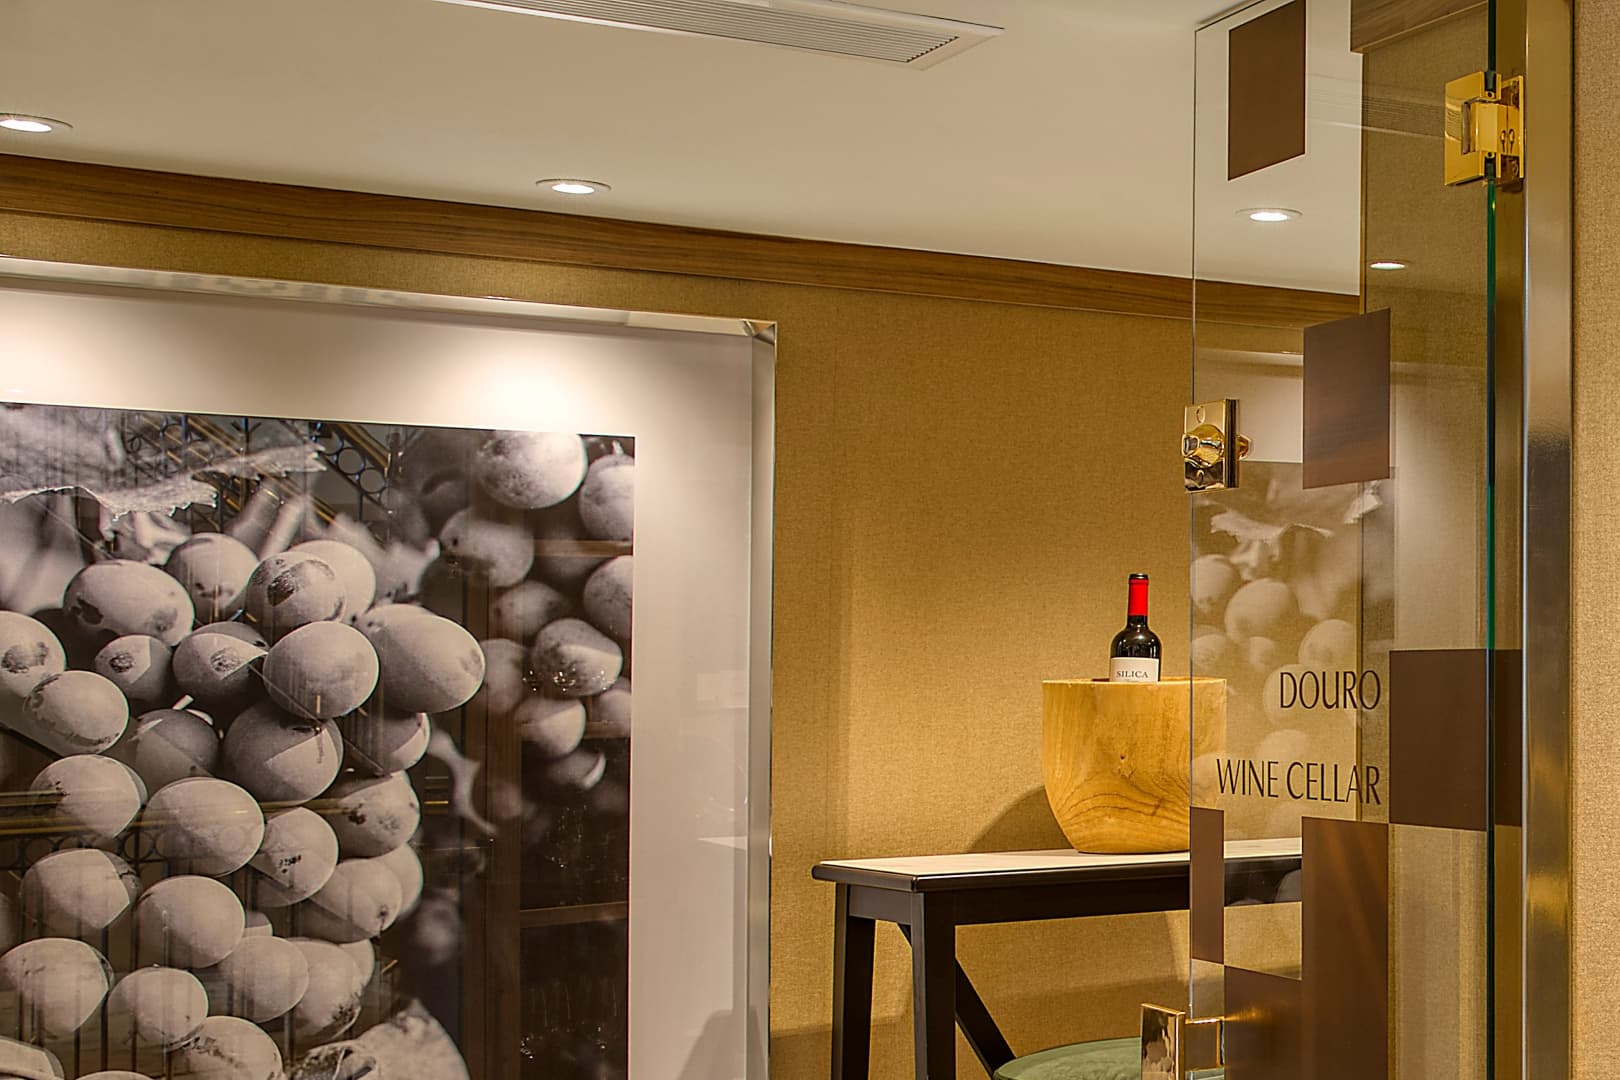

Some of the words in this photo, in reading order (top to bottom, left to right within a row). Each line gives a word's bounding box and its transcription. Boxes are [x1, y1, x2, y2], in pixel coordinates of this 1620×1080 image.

[1116, 670, 1149, 678] SILICA
[1280, 670, 1381, 710] DOURO
[1216, 758, 1279, 798] WINE
[1286, 761, 1381, 805] CELLAR
